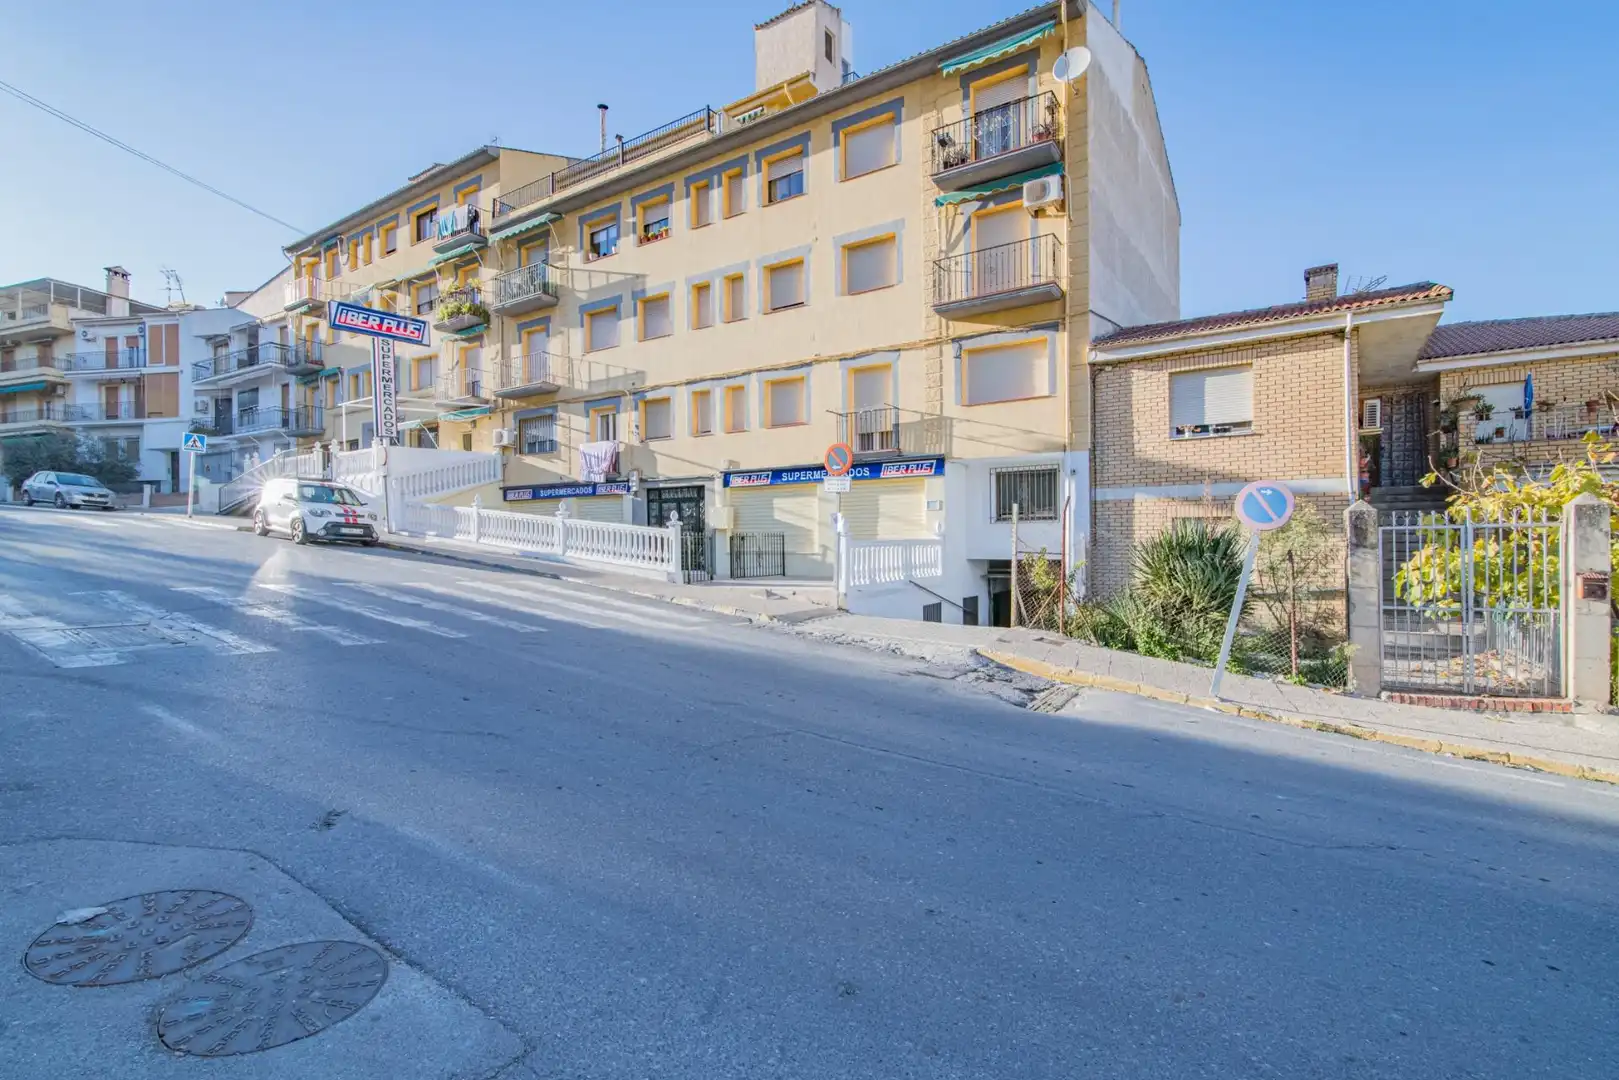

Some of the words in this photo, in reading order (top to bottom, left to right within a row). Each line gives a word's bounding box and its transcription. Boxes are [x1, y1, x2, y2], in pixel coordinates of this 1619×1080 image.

[381, 319, 420, 337] PLUS
[381, 339, 394, 435] SUPERMERCADOS
[781, 467, 870, 481] SUPERMERDOS
[908, 463, 931, 474] PLUS
[540, 486, 593, 497] SUPERMERCADOS
